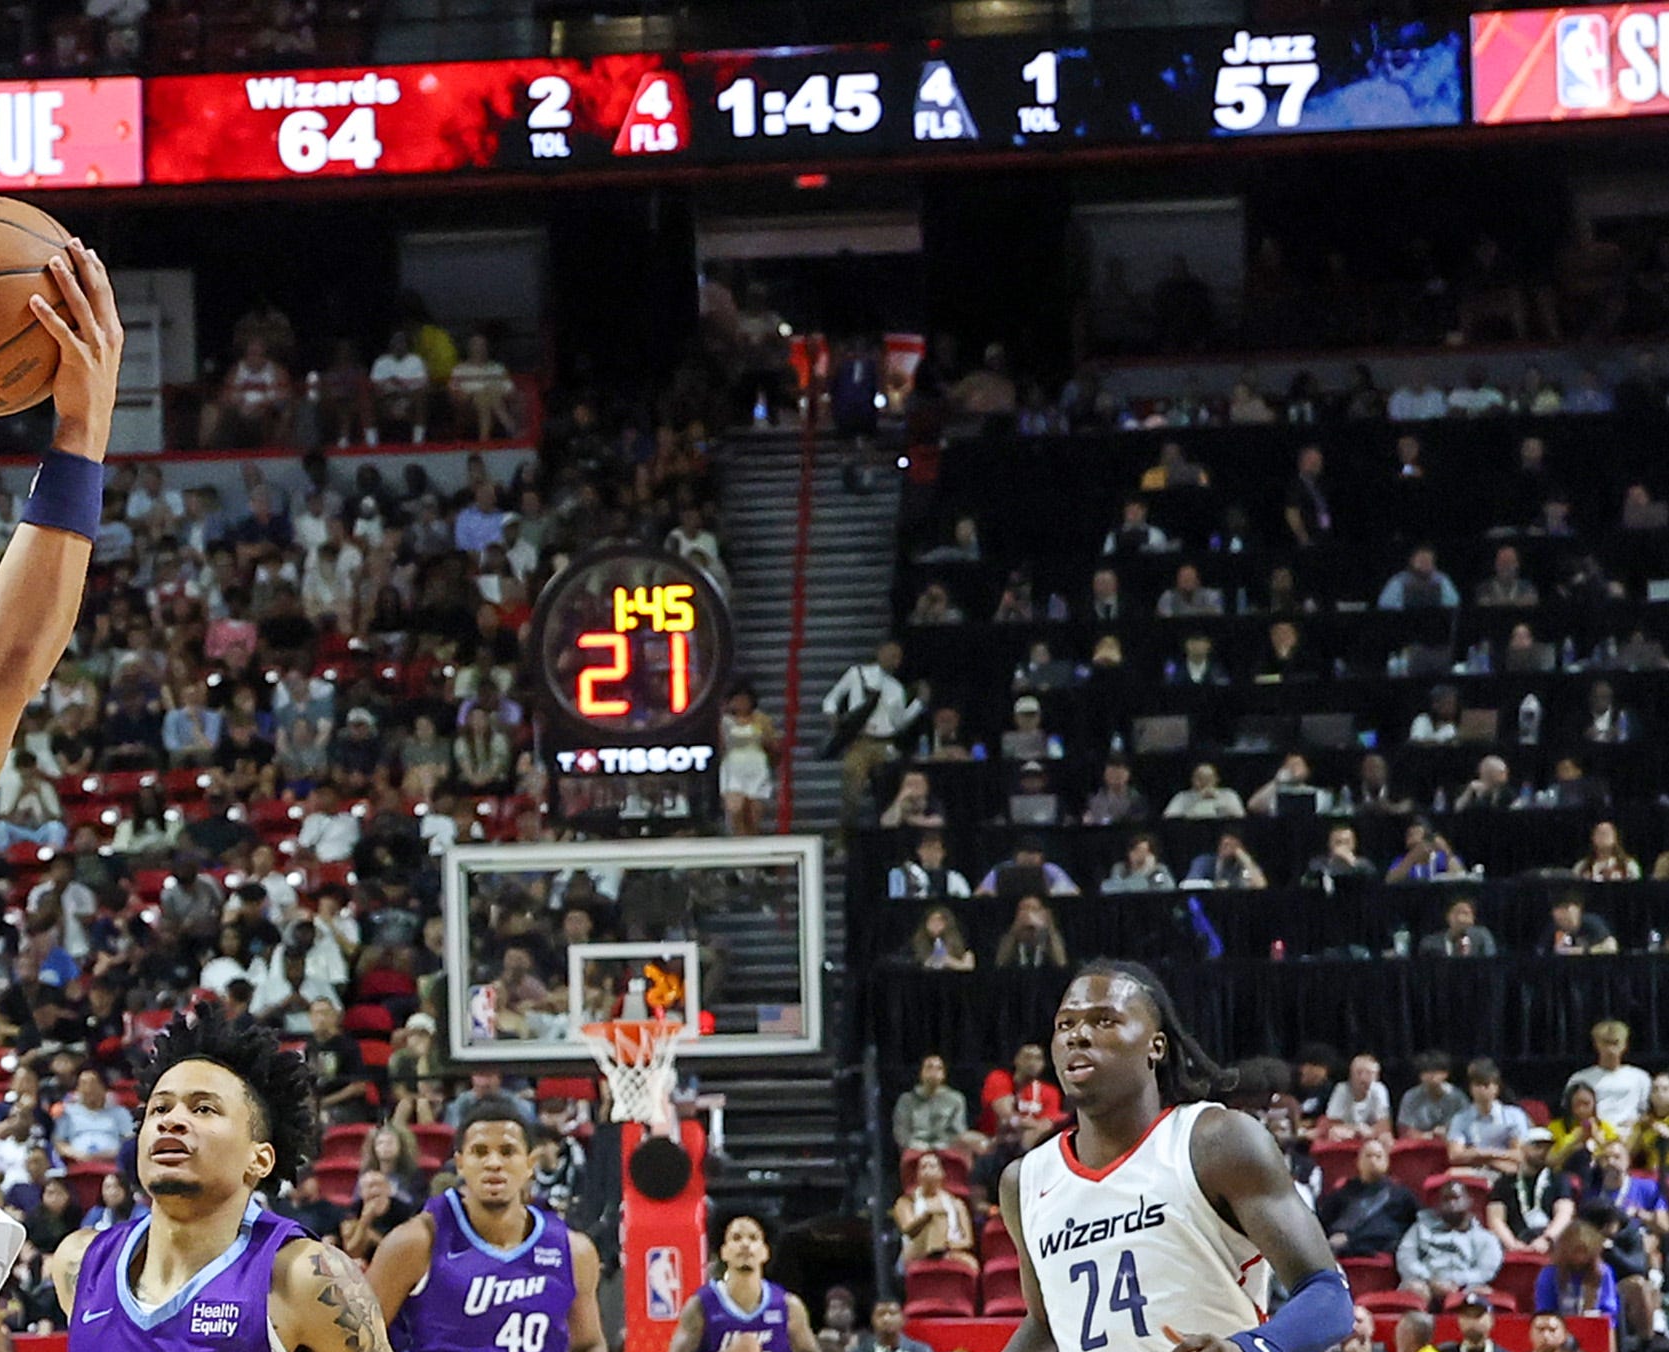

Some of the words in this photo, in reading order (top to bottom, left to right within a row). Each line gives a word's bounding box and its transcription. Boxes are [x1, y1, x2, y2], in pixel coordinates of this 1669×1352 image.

[1223, 31, 1316, 65] Jazz
[246, 74, 400, 109] Wizards
[919, 67, 957, 107] 4
[1022, 51, 1059, 103] 1
[1213, 63, 1320, 129] 57
[528, 77, 572, 129] 2
[636, 79, 672, 120] 4
[717, 74, 882, 138] 1:45
[277, 109, 382, 173] 64
[630, 124, 678, 152] FLS
[915, 111, 961, 139] FLS
[614, 584, 695, 632] 1:45
[577, 631, 689, 716] 21
[597, 745, 714, 774] TISSOT
[1038, 1194, 1169, 1259] wizards
[192, 1302, 239, 1319] Health
[464, 1276, 546, 1316] UTAH
[1069, 1249, 1150, 1352] 24
[190, 1318, 238, 1337] Equity
